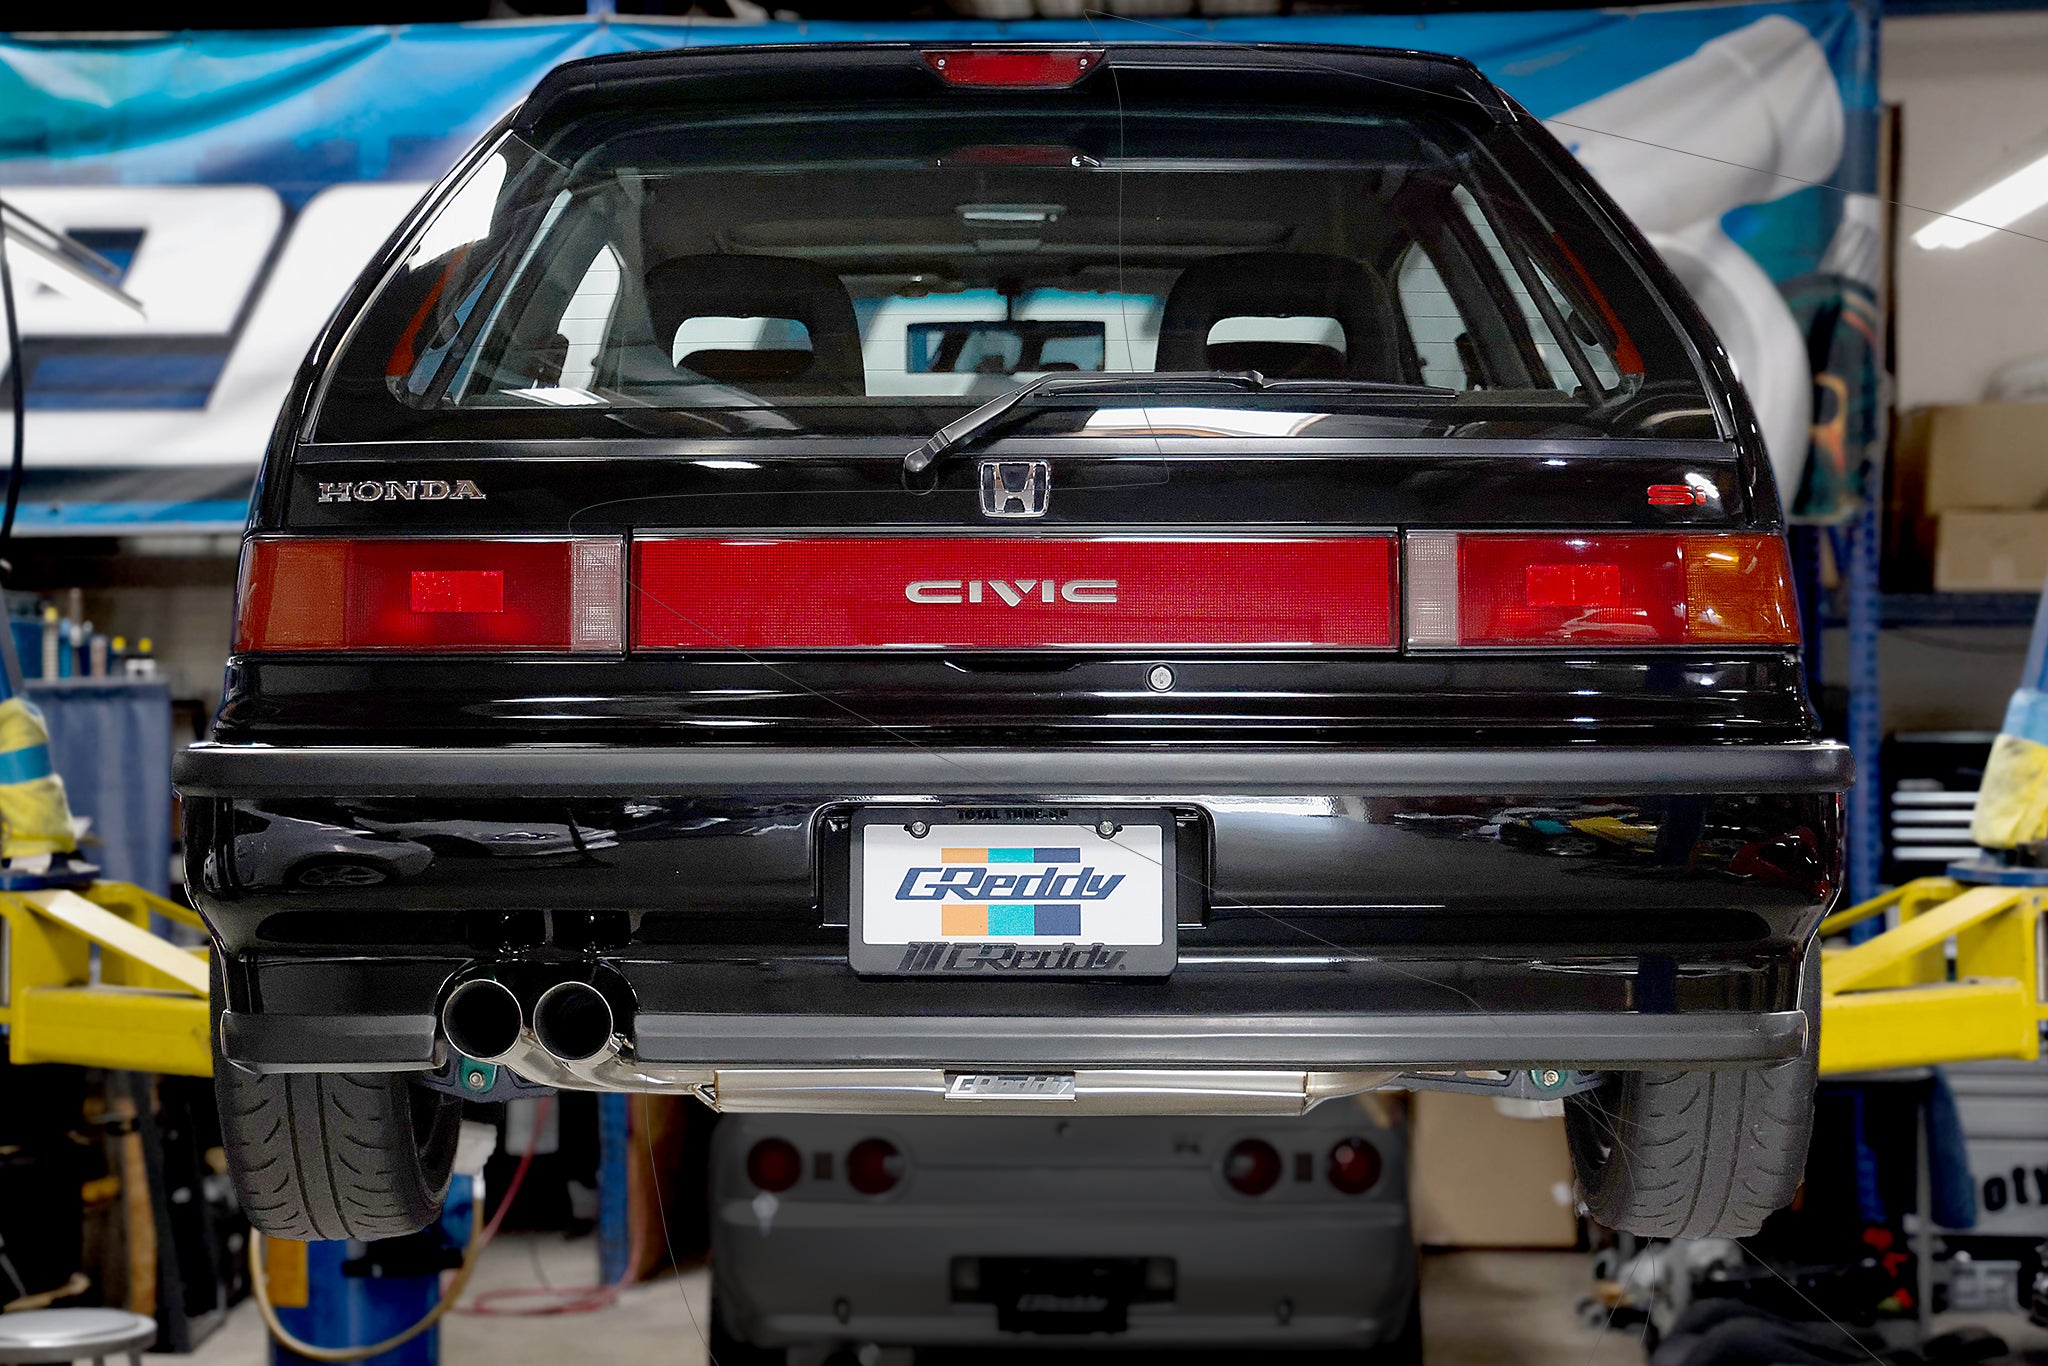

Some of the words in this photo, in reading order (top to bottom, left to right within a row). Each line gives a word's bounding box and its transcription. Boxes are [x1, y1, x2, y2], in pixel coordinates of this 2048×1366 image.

[318, 480, 487, 502] HONDA
[1647, 485, 1707, 505] Si
[905, 579, 1118, 607] CIVIC
[957, 808, 1000, 820] TOTAL
[1005, 808, 1069, 820] TUNE-UP
[895, 866, 1127, 900] GReddy
